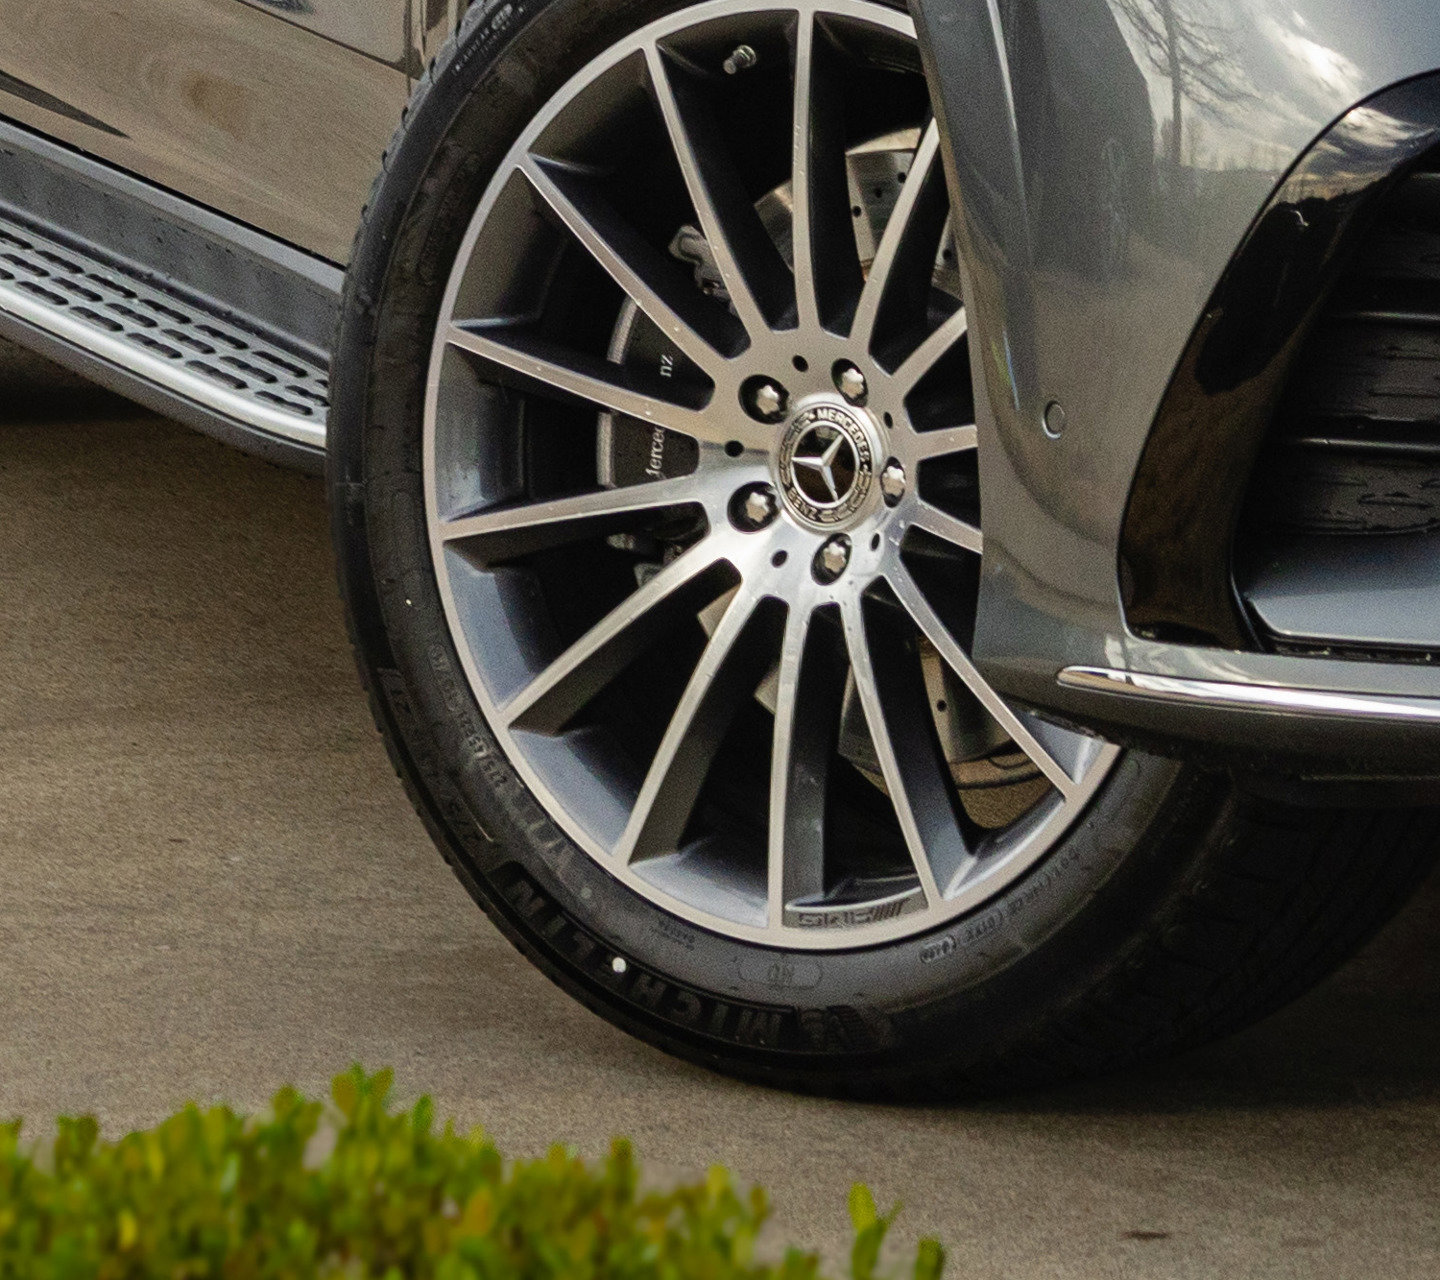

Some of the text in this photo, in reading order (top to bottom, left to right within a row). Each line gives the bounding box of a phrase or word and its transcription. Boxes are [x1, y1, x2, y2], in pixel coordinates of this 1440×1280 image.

[816, 407, 871, 463] MERCEDES
[787, 486, 819, 521] BENZ
[500, 871, 781, 1047] MICHELIN
